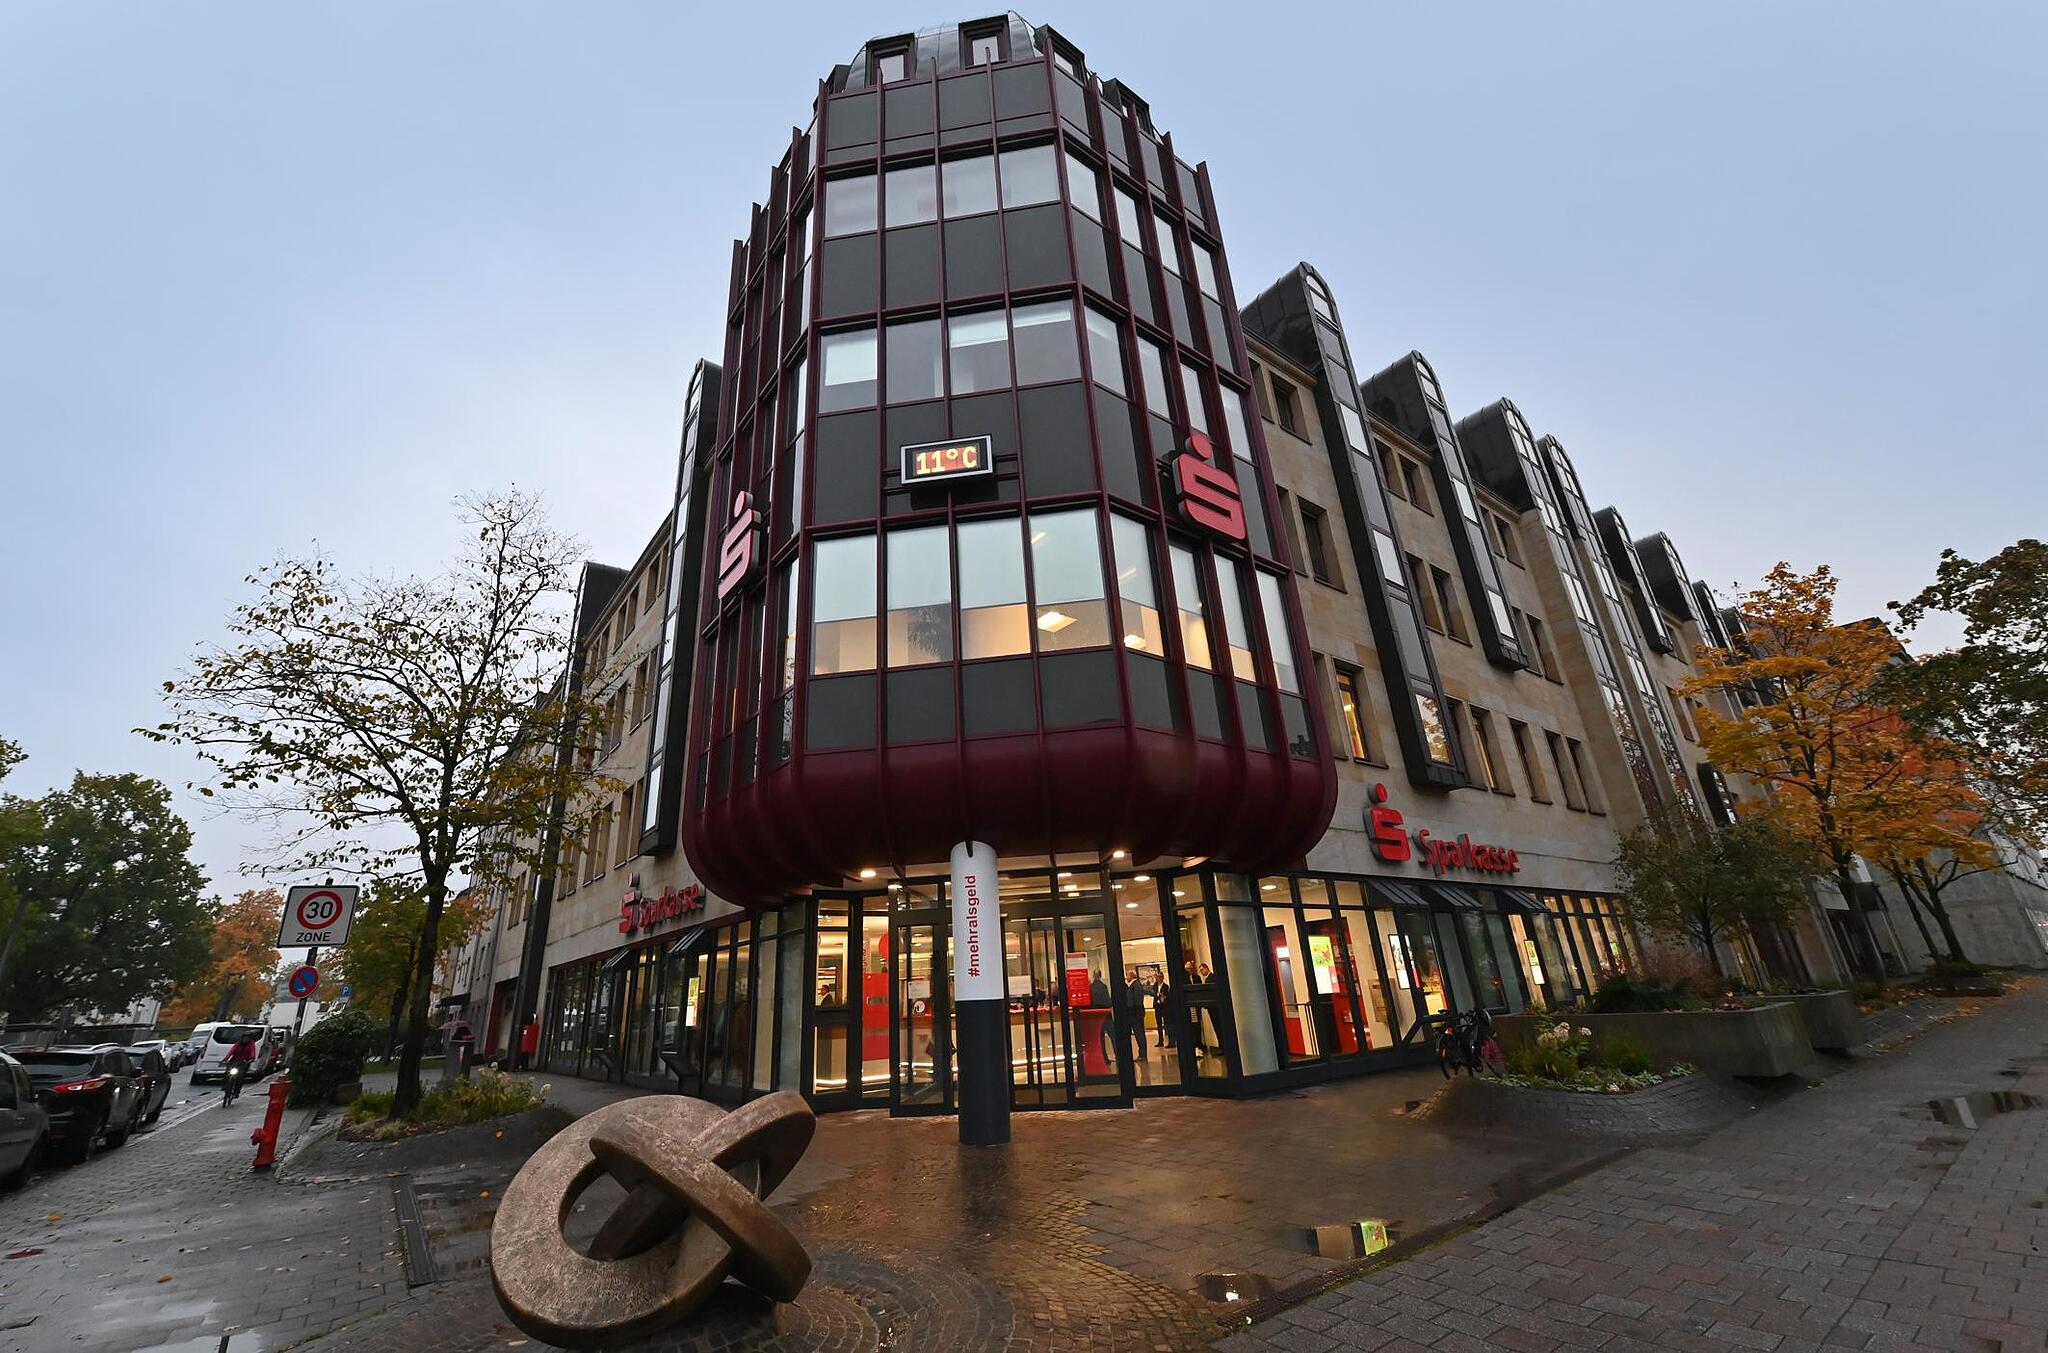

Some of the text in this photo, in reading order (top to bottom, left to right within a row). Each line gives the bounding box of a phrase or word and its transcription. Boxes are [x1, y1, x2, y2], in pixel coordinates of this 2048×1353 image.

[915, 446, 978, 475] 11°C
[1417, 828, 1521, 876] Sparkasse
[306, 901, 334, 919] 30
[296, 931, 332, 943] ZONE
[965, 875, 981, 978] #mehralsgeld
